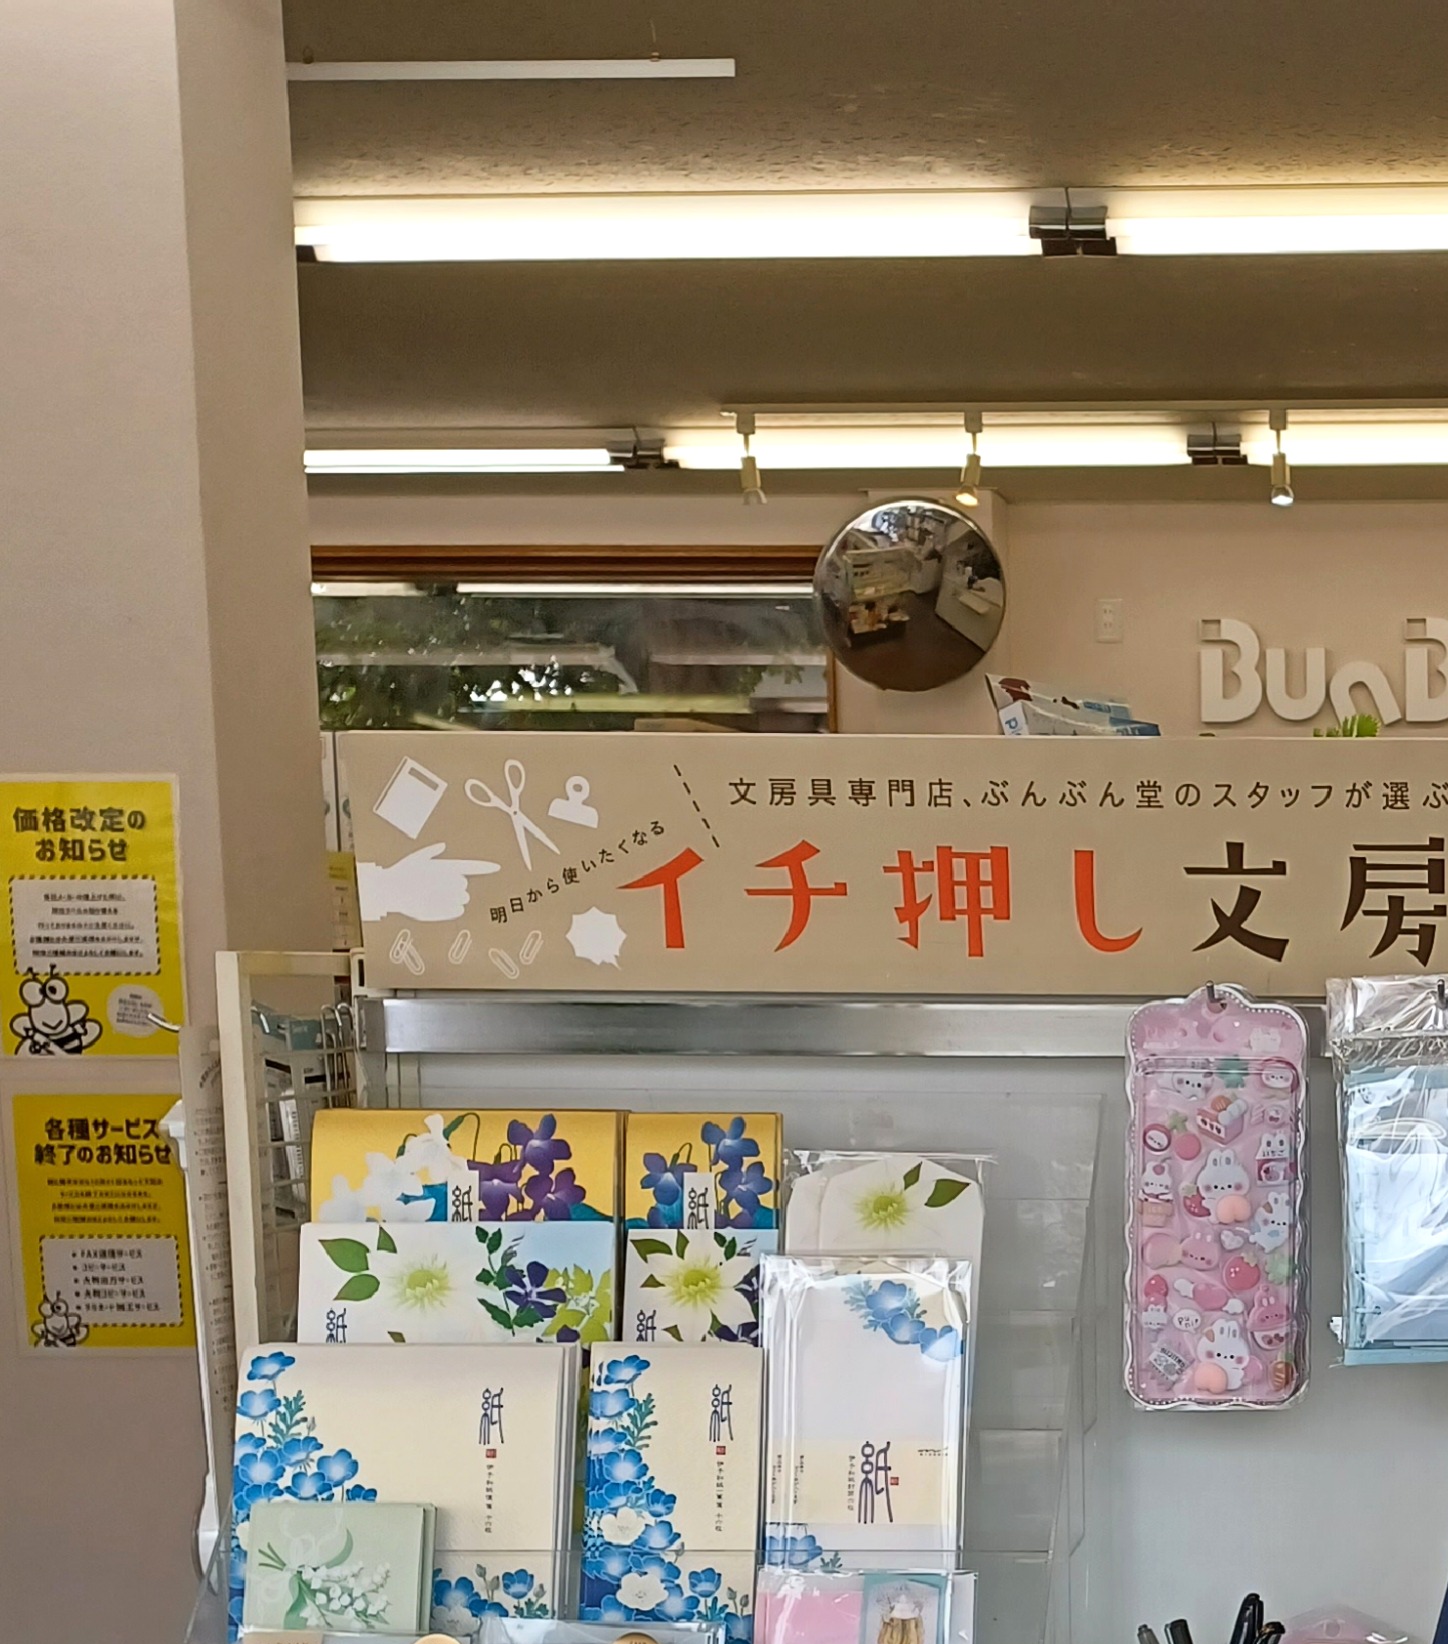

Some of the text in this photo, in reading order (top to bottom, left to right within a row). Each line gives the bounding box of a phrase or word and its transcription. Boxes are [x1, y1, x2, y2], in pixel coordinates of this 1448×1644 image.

[13, 806, 146, 833] 価格改定の
[35, 838, 128, 862] お知らせ
[489, 819, 667, 924] 明日から使いたくなる
[45, 1118, 160, 1141] 各種サービス
[34, 1143, 171, 1166] 終了のお知らせ
